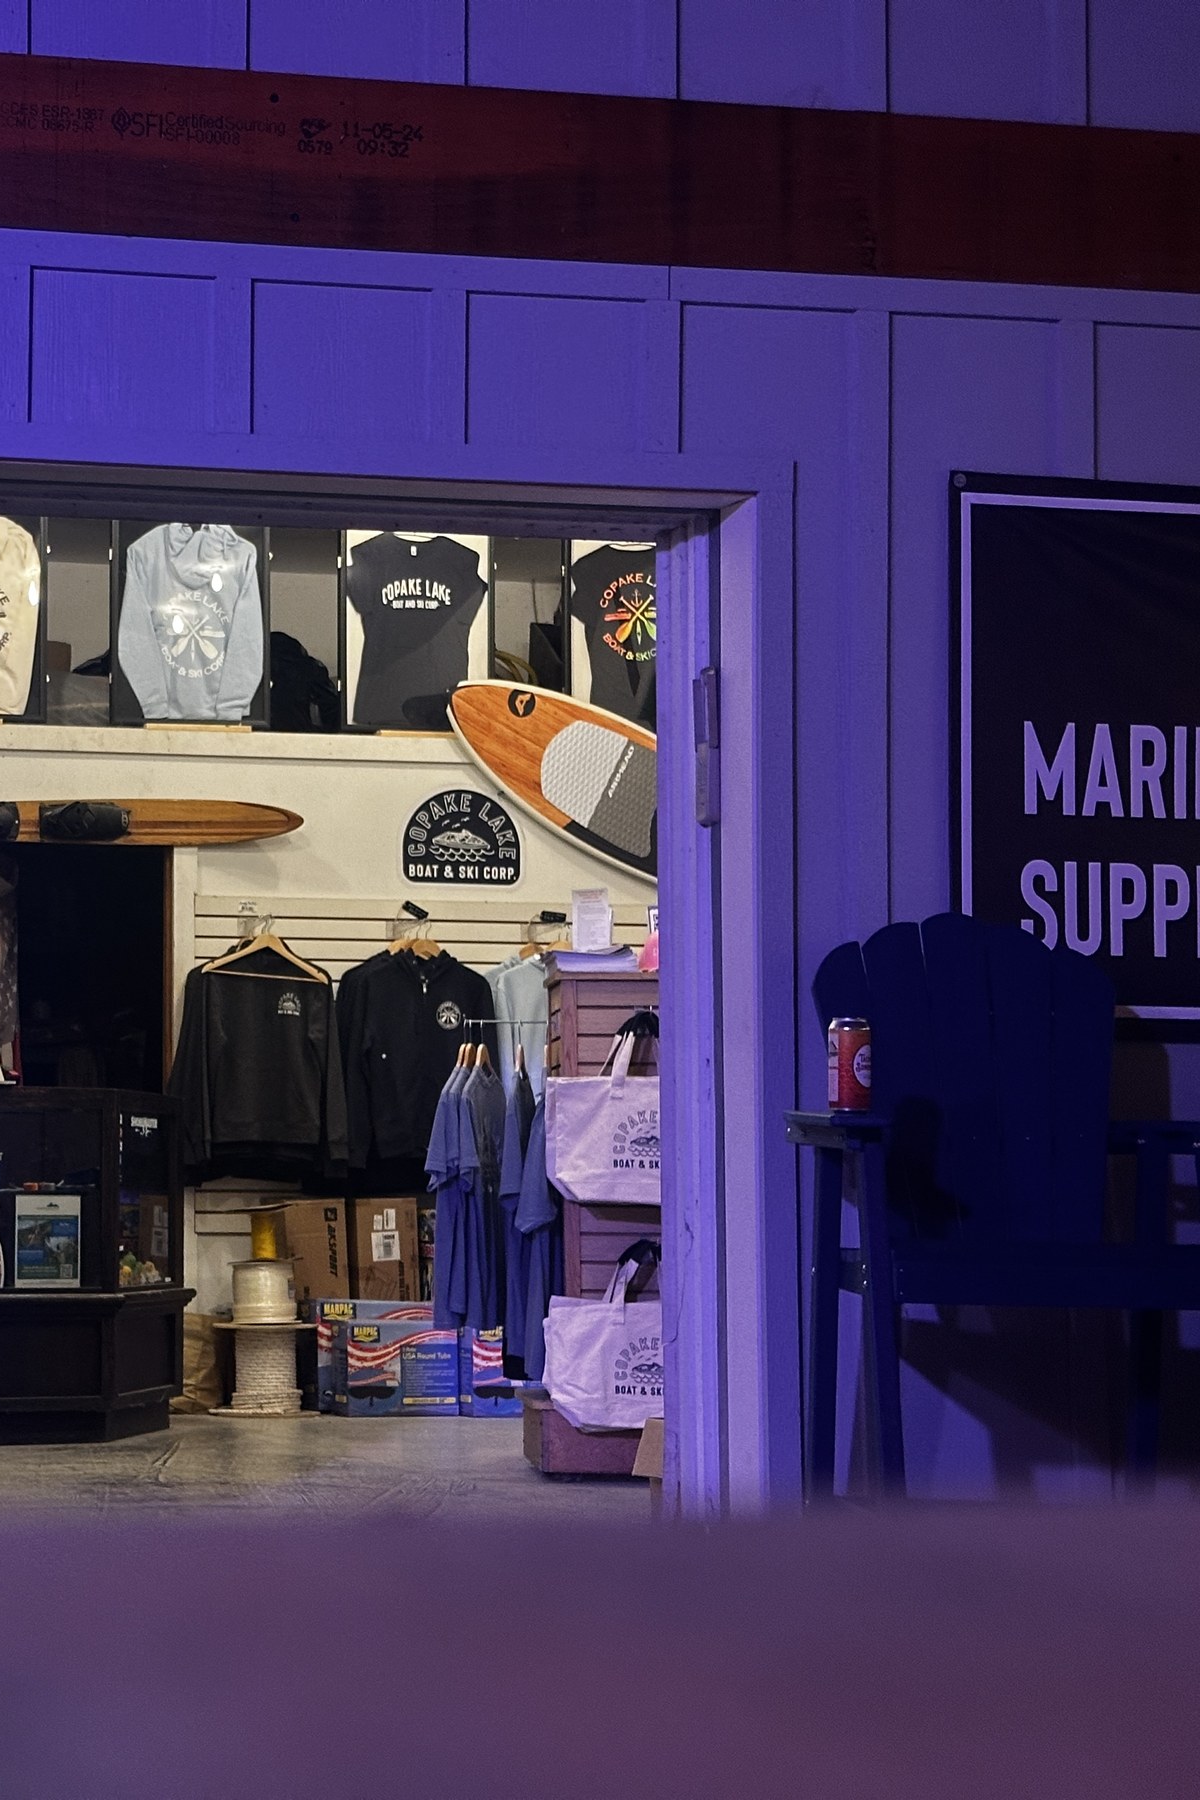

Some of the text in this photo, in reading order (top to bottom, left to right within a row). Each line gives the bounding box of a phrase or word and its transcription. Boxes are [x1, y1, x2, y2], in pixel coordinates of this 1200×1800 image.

[130, 111, 163, 138] SFI
[165, 111, 225, 130] Certified
[342, 120, 425, 142] 11-05-24
[356, 139, 410, 158] 09:32
[382, 578, 451, 606] COPAKE LAKE
[600, 573, 644, 608] COPAKE
[202, 595, 230, 625] LAKE
[603, 632, 627, 657] BOAT
[625, 651, 635, 661] &
[636, 651, 651, 662] SKI
[178, 666, 187, 676] &
[188, 669, 203, 678] SKI
[407, 793, 517, 860] COPAKE LAKE
[408, 864, 517, 881] BOAT & SKI CORP.
[612, 1110, 658, 1155] COPAKE
[613, 1159, 635, 1169] BOAT
[638, 1160, 646, 1169] &
[323, 1303, 353, 1316] MARPAC
[353, 1326, 379, 1337] MARPAC
[614, 1337, 660, 1381] COPAKE
[614, 1385, 663, 1396] BOAT & SK
